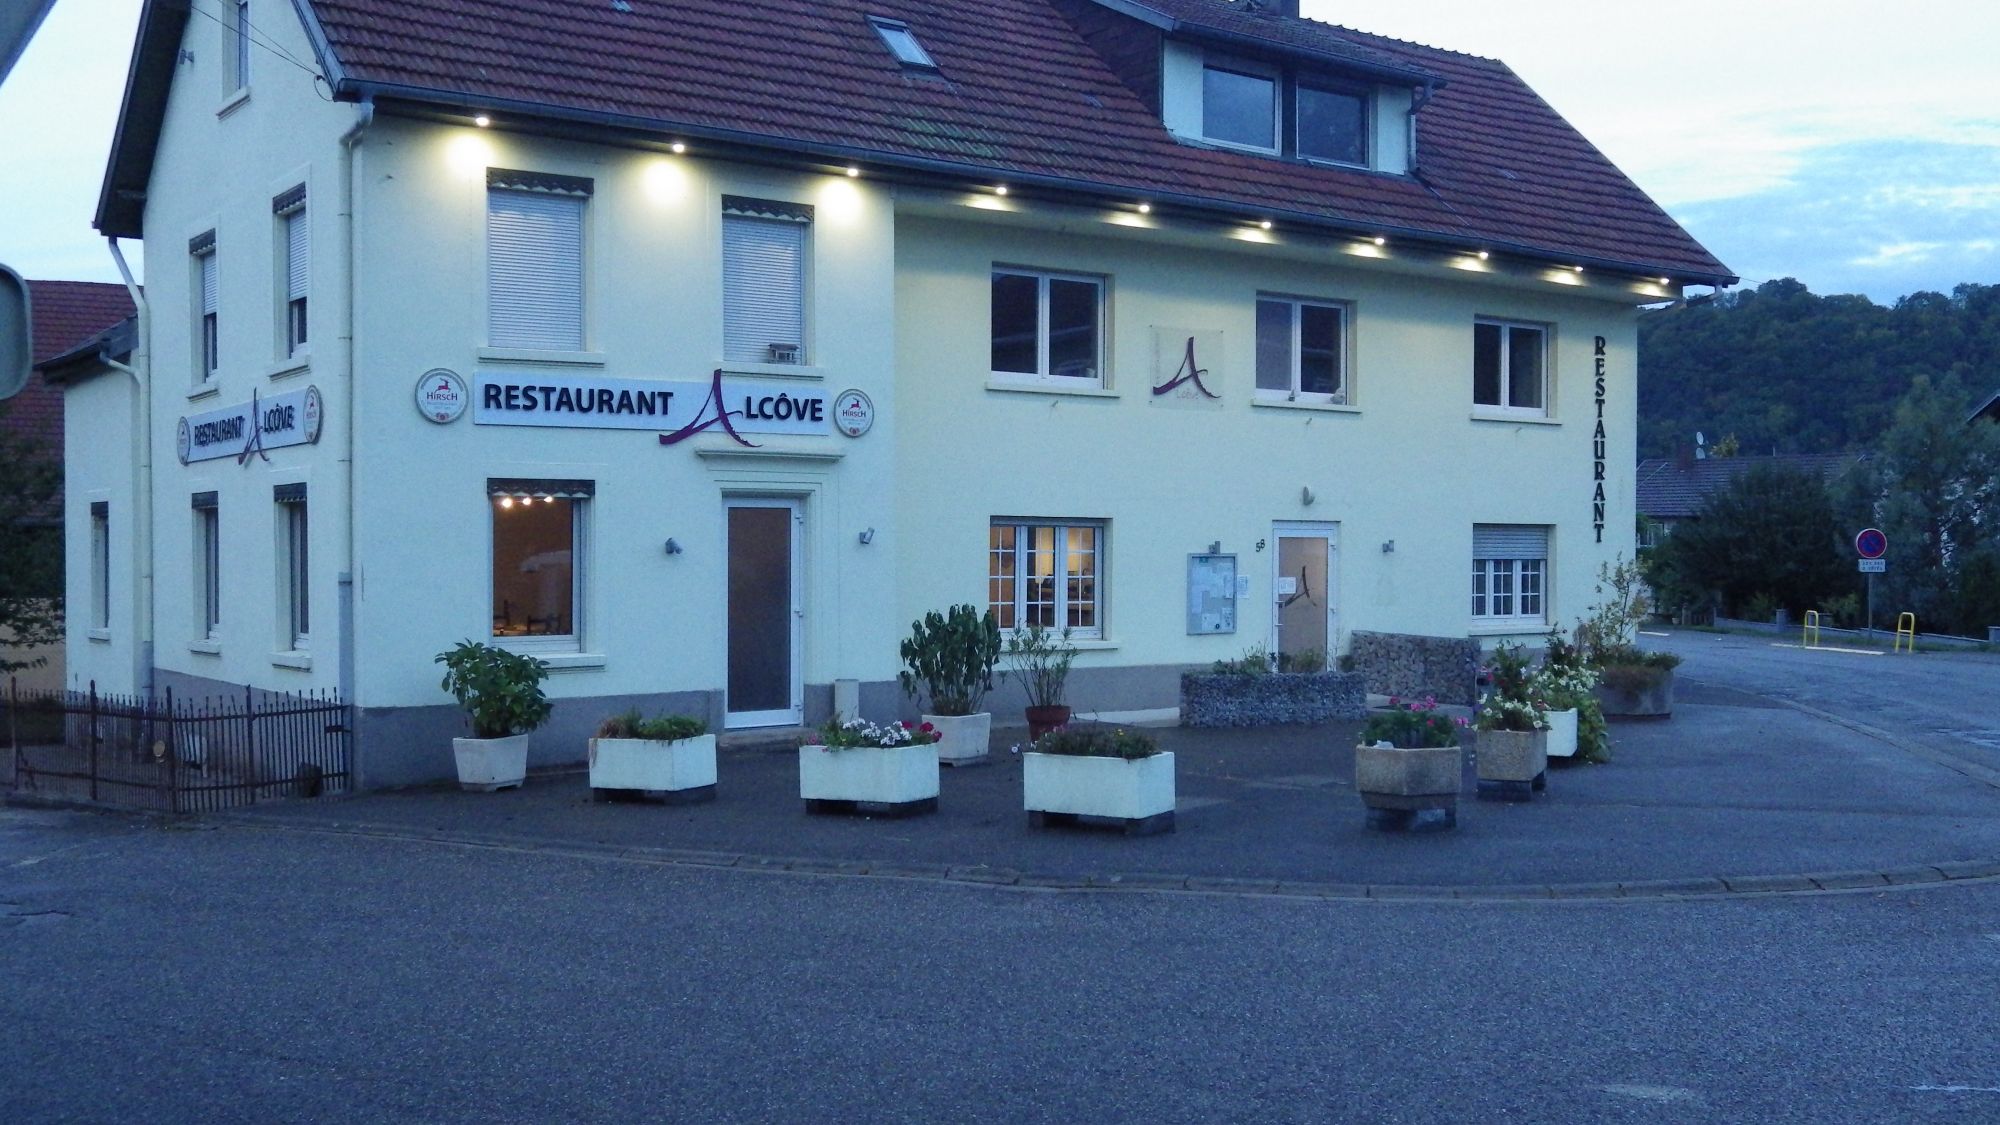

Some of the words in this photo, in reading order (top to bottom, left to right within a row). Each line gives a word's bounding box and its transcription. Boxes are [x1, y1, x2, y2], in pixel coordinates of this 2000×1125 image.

[484, 384, 674, 415] RESTAURANT
[194, 415, 244, 447] RESTAURANT
[1594, 336, 1605, 543] RESTAURANT
[1255, 538, 1266, 552] 58
